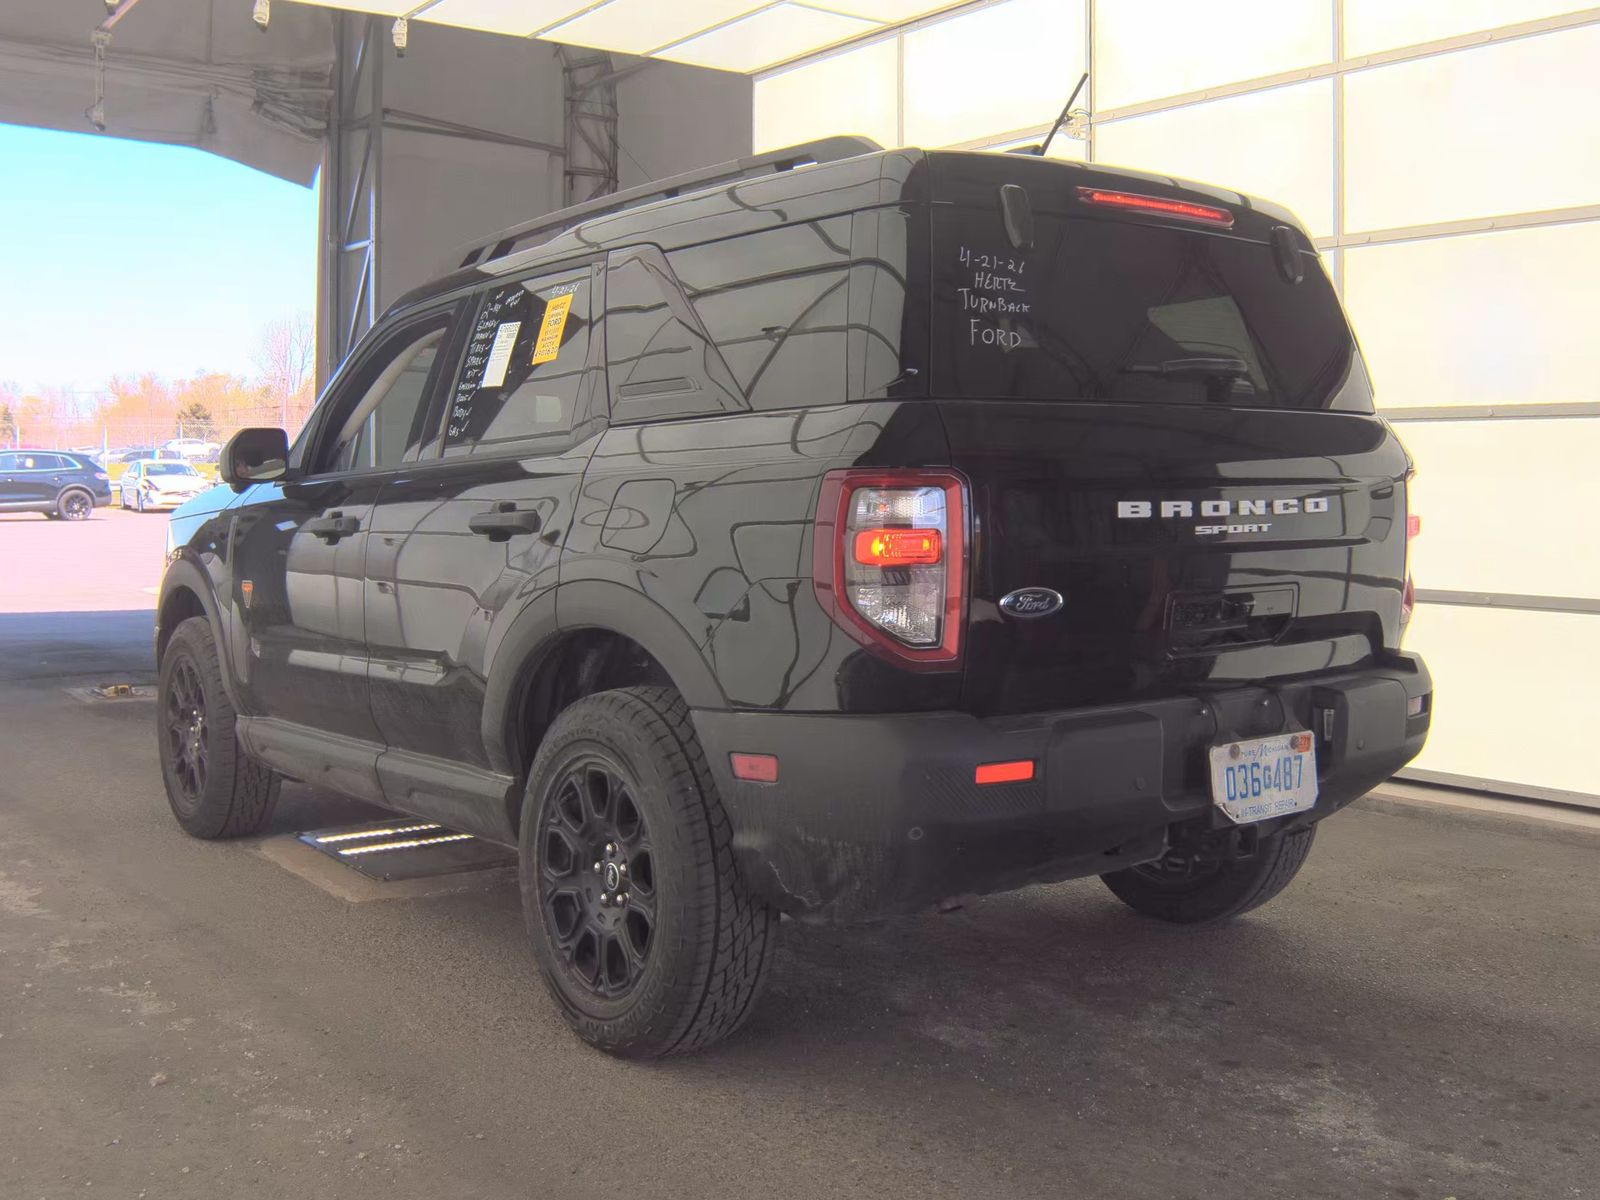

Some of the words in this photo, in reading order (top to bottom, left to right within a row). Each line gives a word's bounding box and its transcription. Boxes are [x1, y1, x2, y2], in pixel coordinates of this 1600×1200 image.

[960, 246, 1025, 273] 4-21-26
[975, 271, 1025, 291] HERTZ
[547, 317, 562, 327] FORD
[970, 319, 1021, 348] FORD
[1117, 497, 1329, 519] BRONCO
[1194, 523, 1273, 535] SPORT
[1015, 591, 1051, 611] Ford
[1225, 755, 1303, 801] 036G487
